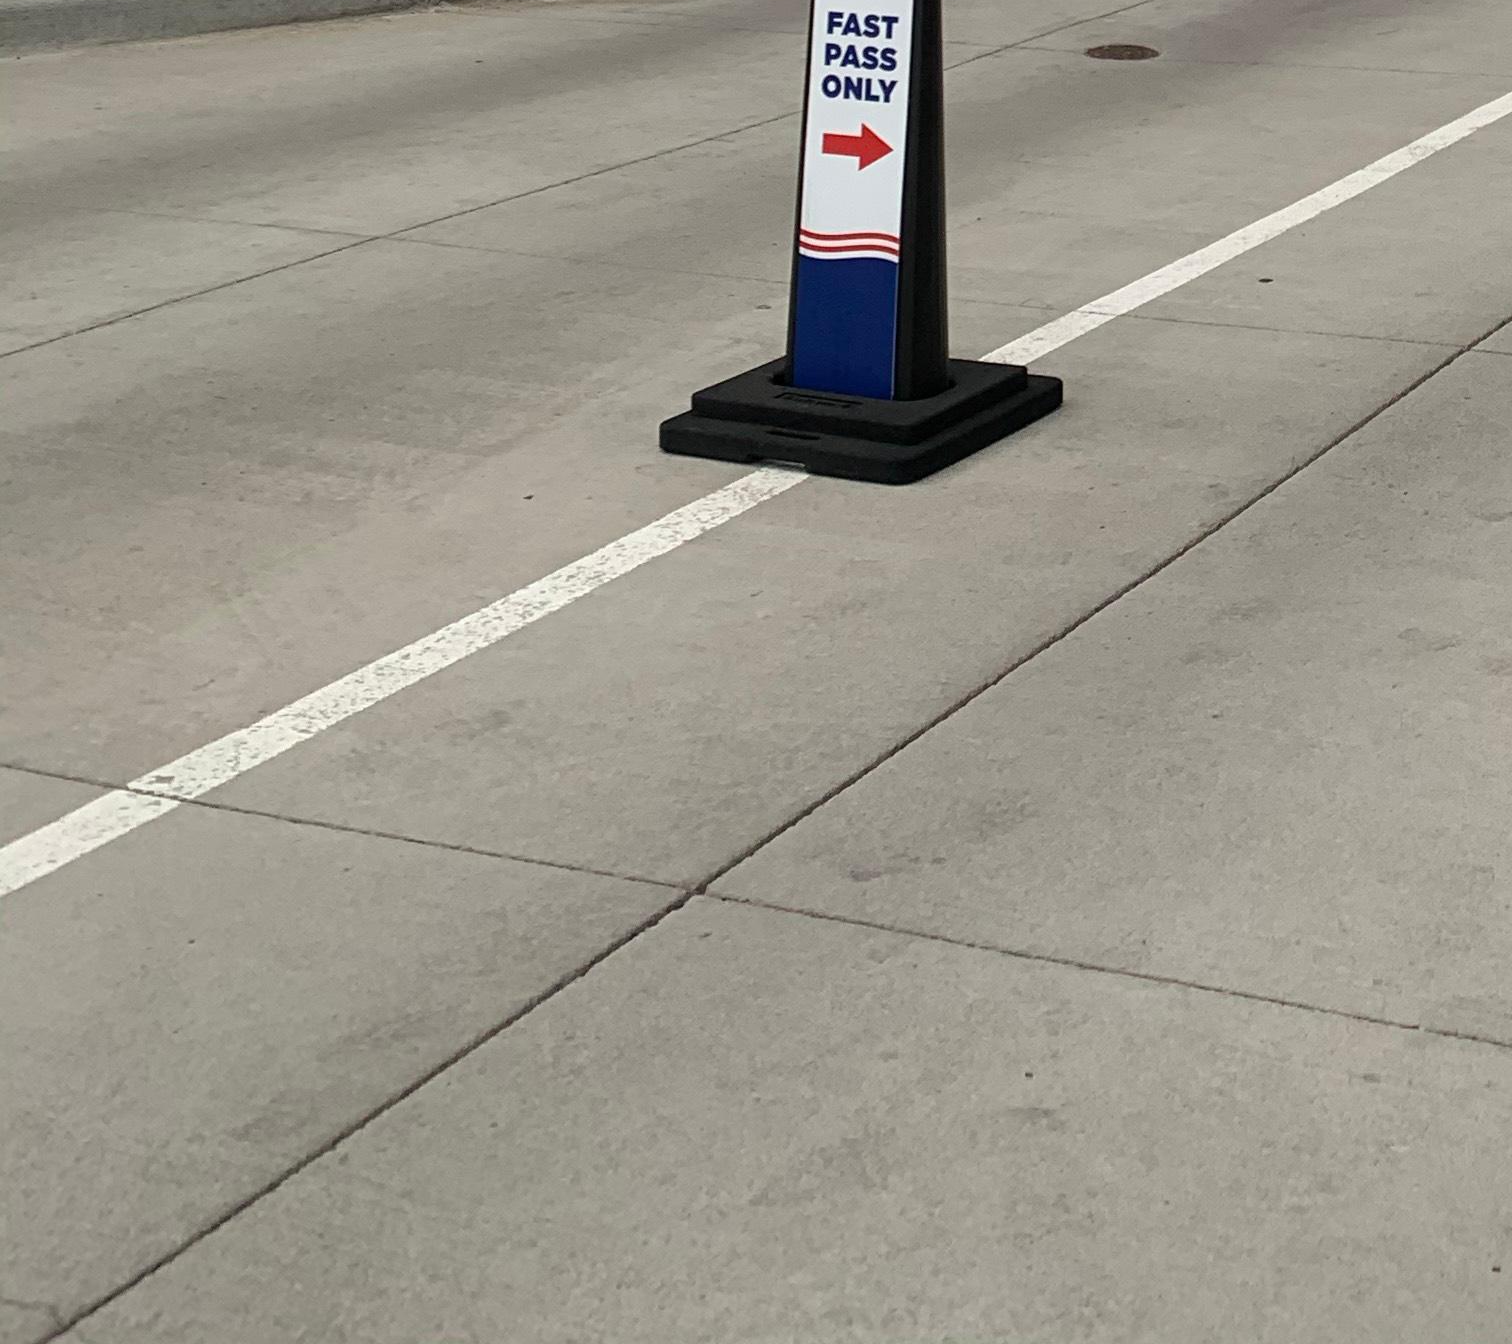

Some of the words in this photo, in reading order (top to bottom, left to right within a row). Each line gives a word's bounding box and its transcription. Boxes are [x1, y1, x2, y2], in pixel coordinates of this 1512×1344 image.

[826, 11, 899, 39] FAST
[824, 43, 898, 72] PASS
[821, 75, 898, 104] ONLY
